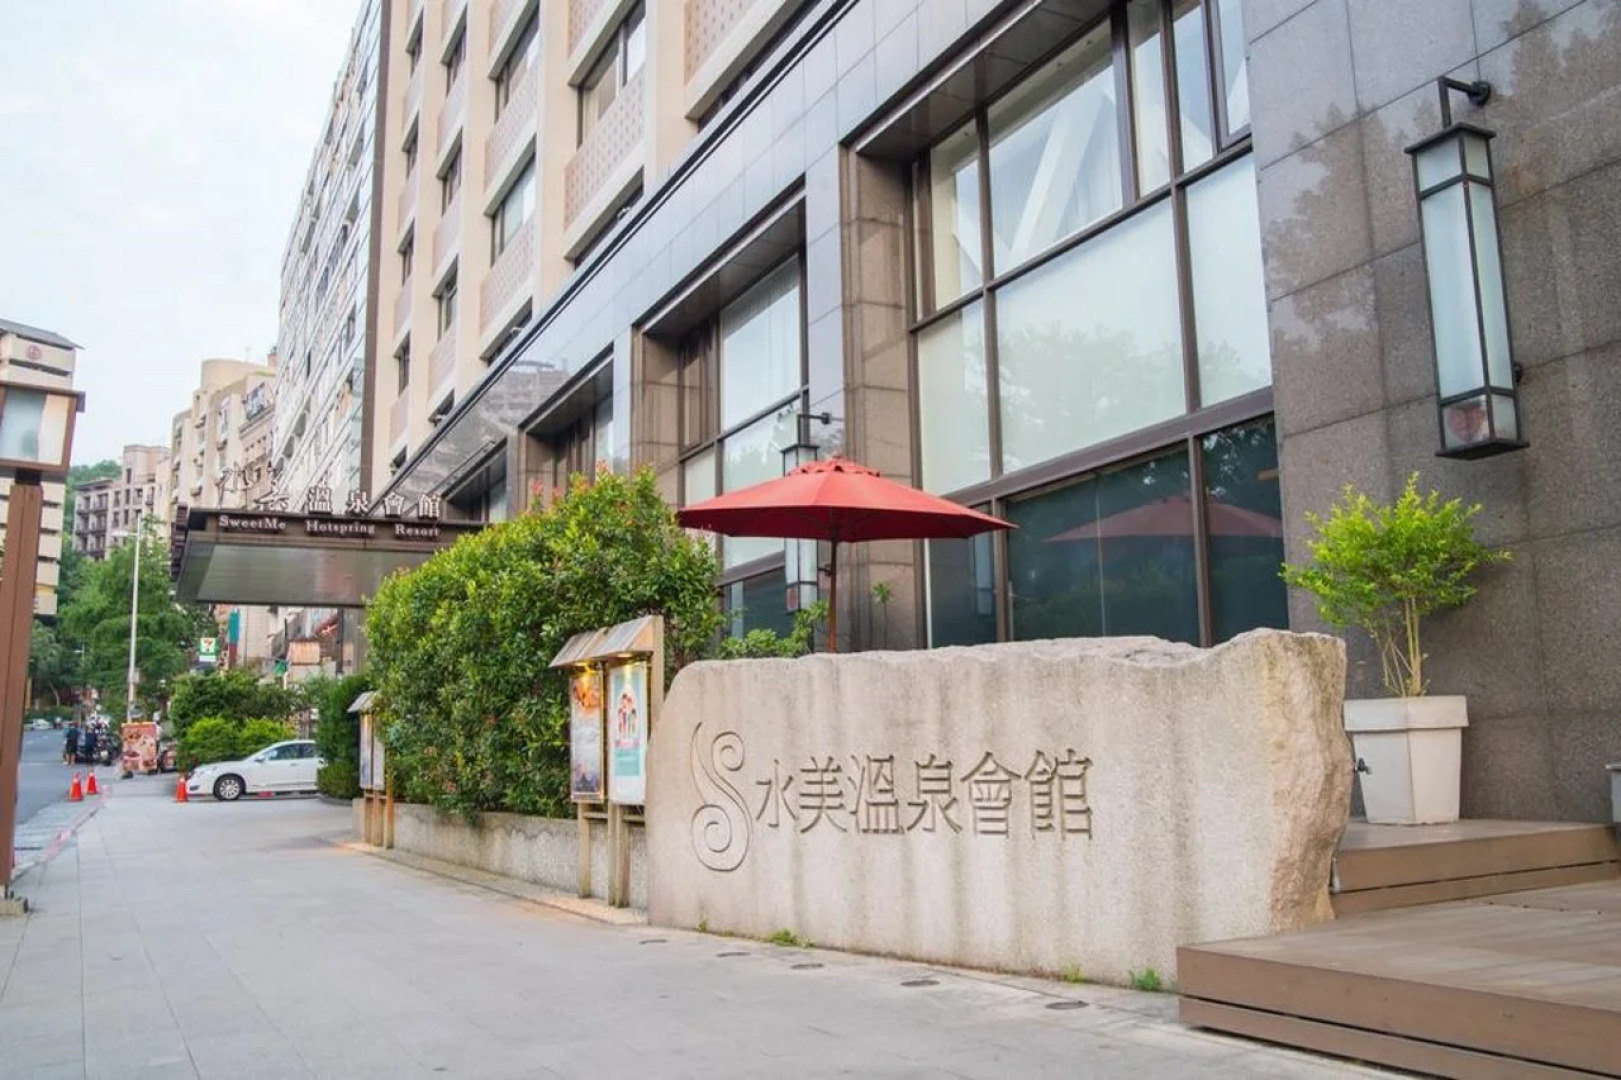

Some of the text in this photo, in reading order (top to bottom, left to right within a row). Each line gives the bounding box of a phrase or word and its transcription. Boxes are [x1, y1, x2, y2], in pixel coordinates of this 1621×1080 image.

[218, 514, 440, 537] SweetMe Hotspring Resort
[755, 748, 1094, 841] 水美溫泉會館
